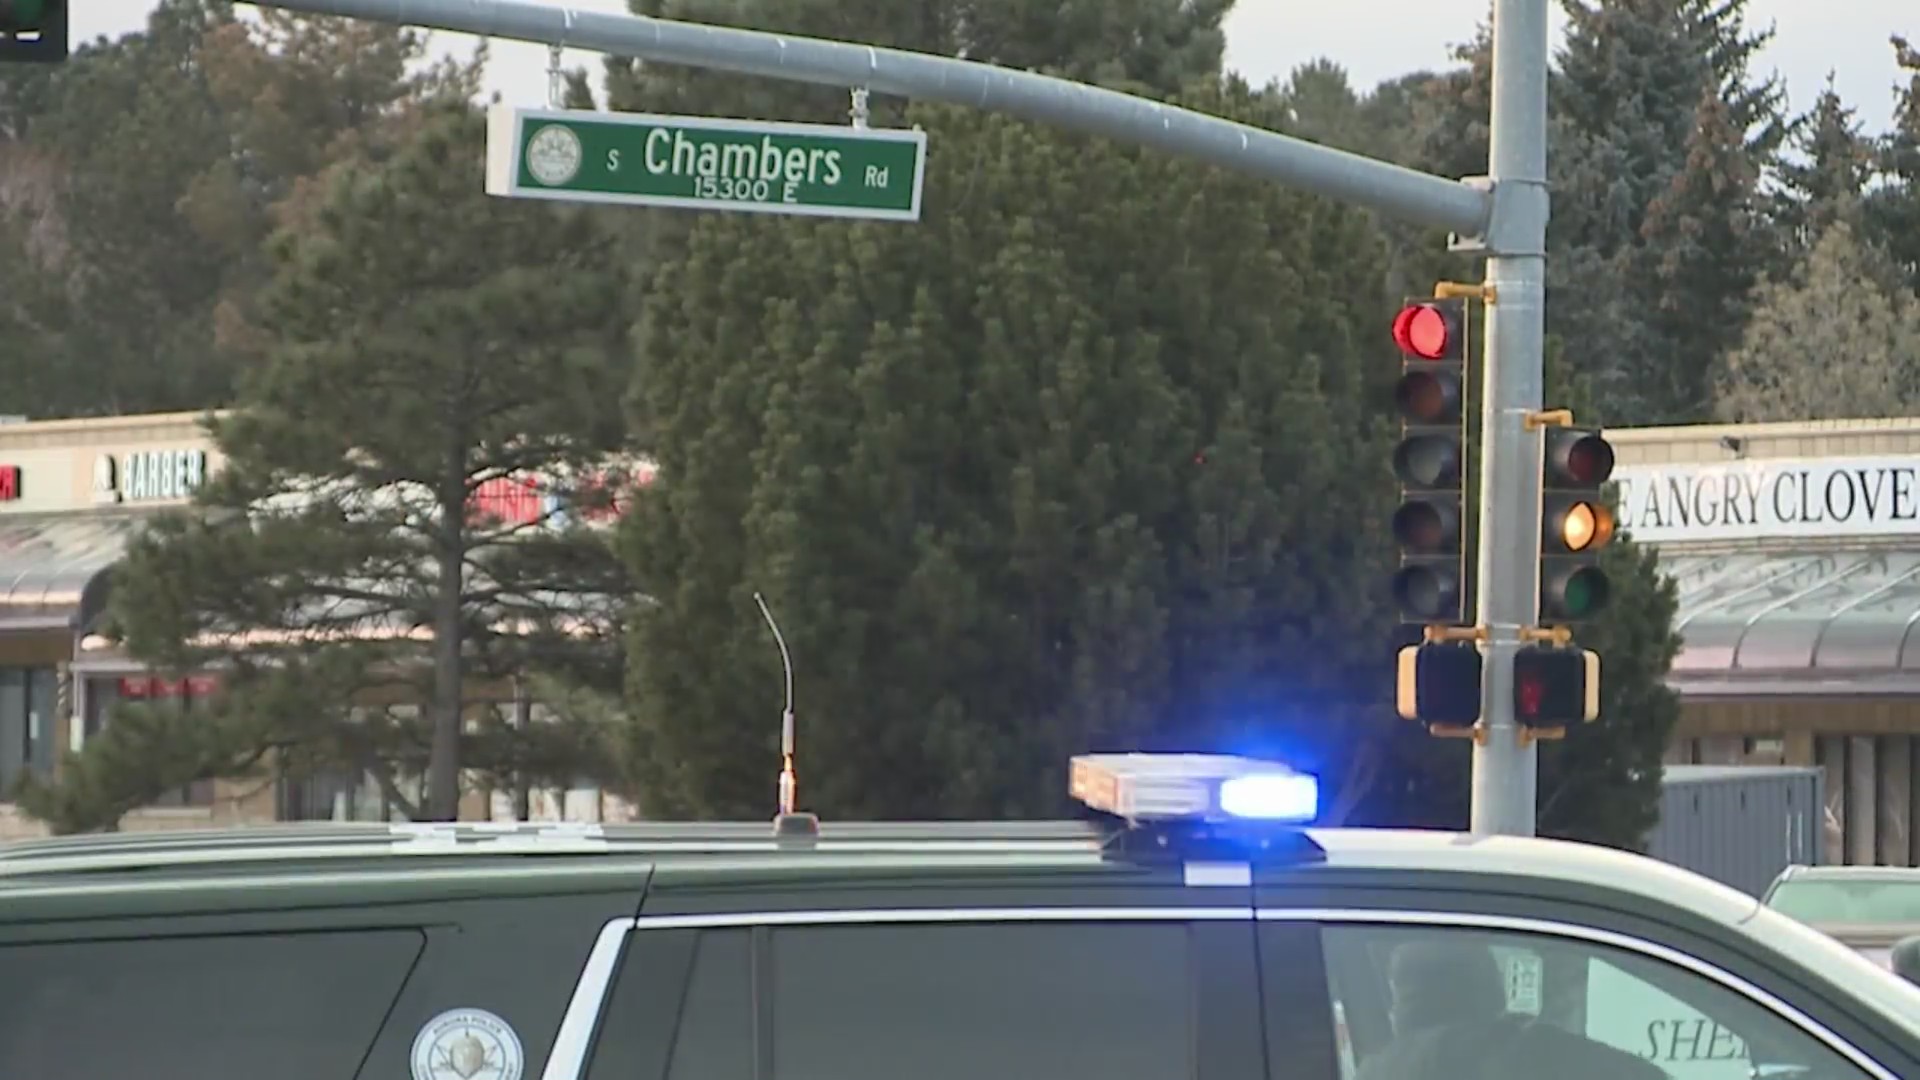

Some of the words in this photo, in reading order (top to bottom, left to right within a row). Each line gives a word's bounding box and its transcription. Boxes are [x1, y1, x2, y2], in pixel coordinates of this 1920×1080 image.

[606, 149, 620, 171] S
[645, 128, 841, 185] Chambers
[864, 165, 889, 187] Rd
[694, 177, 769, 201] 15300
[783, 182, 799, 203] E
[123, 451, 201, 498] BARBER
[1615, 478, 1632, 527] E
[1641, 473, 1762, 527] ANGRY
[1774, 468, 1918, 523] CLOVE
